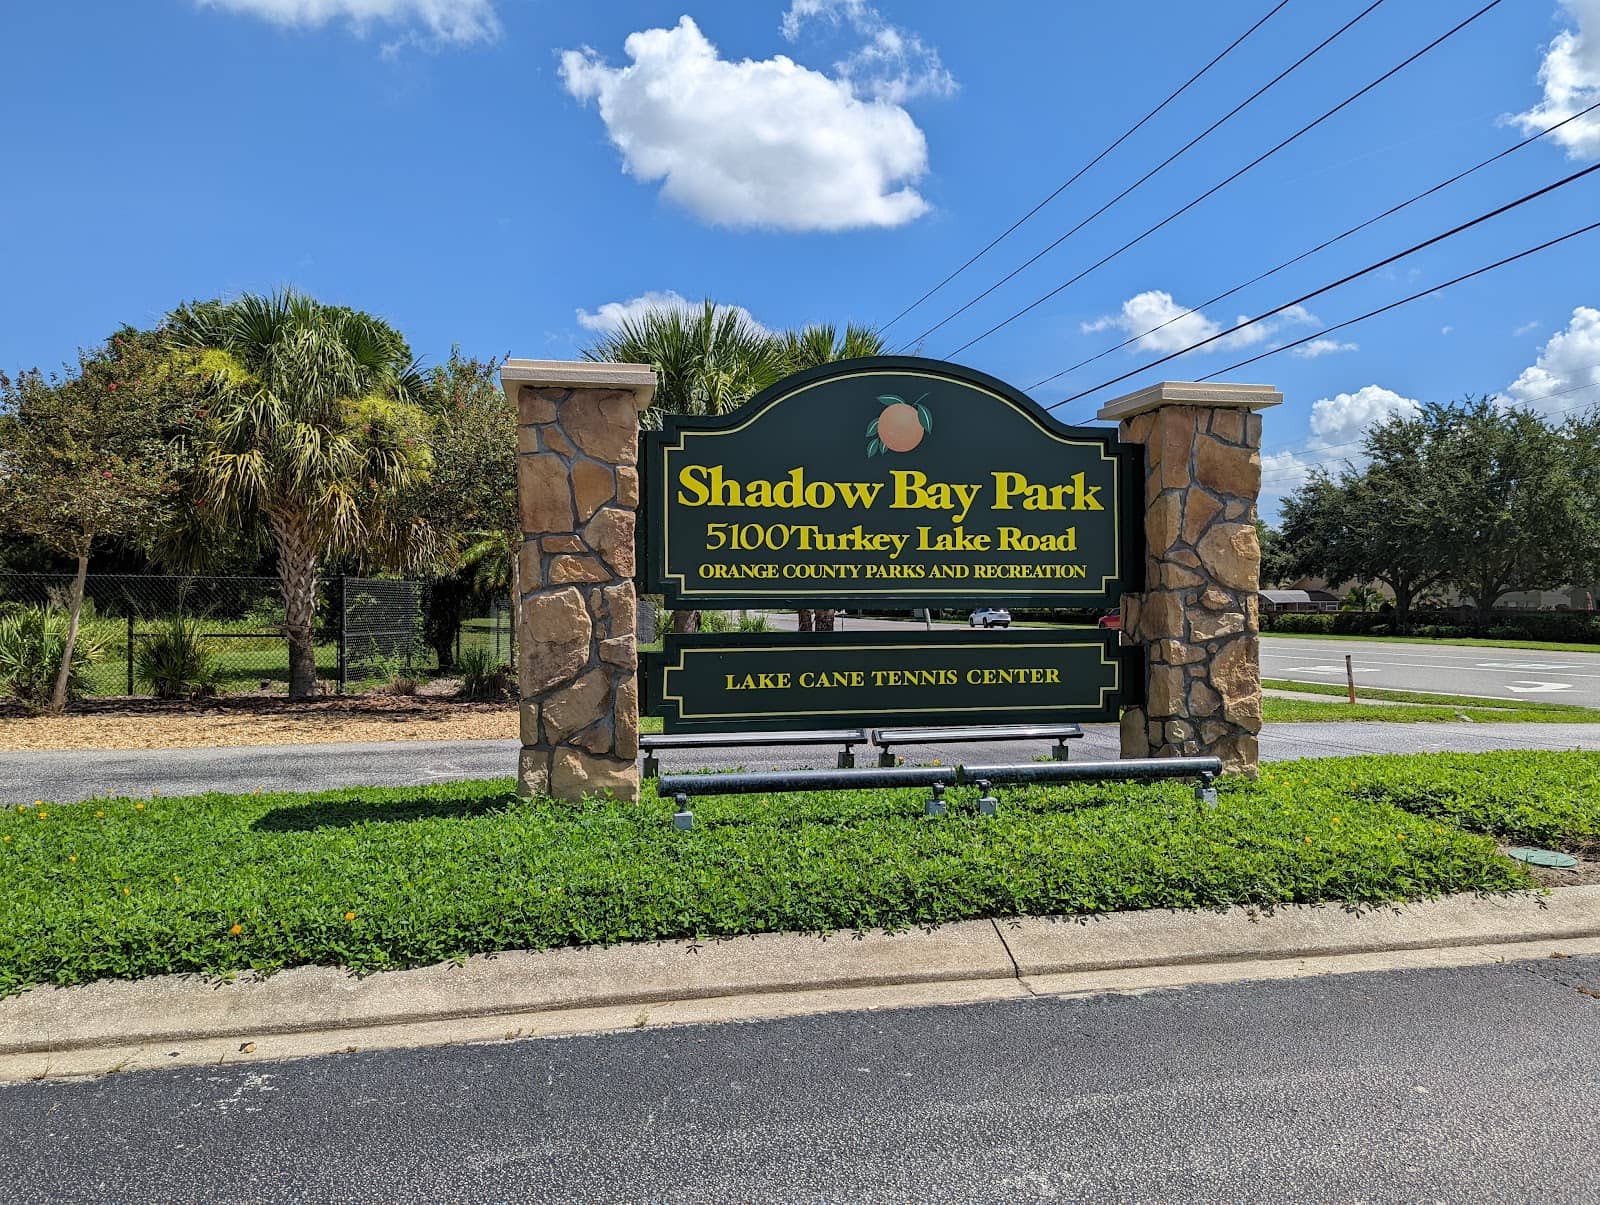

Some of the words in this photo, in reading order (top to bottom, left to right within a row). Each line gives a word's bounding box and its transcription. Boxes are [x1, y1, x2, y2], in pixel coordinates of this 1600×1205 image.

[677, 464, 884, 509] Shadow
[890, 470, 982, 524] Bay
[990, 471, 1105, 511] Park
[917, 525, 992, 552] Lake
[997, 526, 1077, 552] Road
[698, 564, 779, 579] ORANGE
[782, 564, 863, 579] COUNTY
[865, 564, 926, 579] PARKS
[929, 565, 970, 579] AND
[974, 564, 1087, 579] RECREATION
[725, 673, 791, 690] LAKE
[799, 671, 865, 688] CANE
[871, 669, 958, 687] TENNIS
[966, 668, 1061, 685] CENTER
